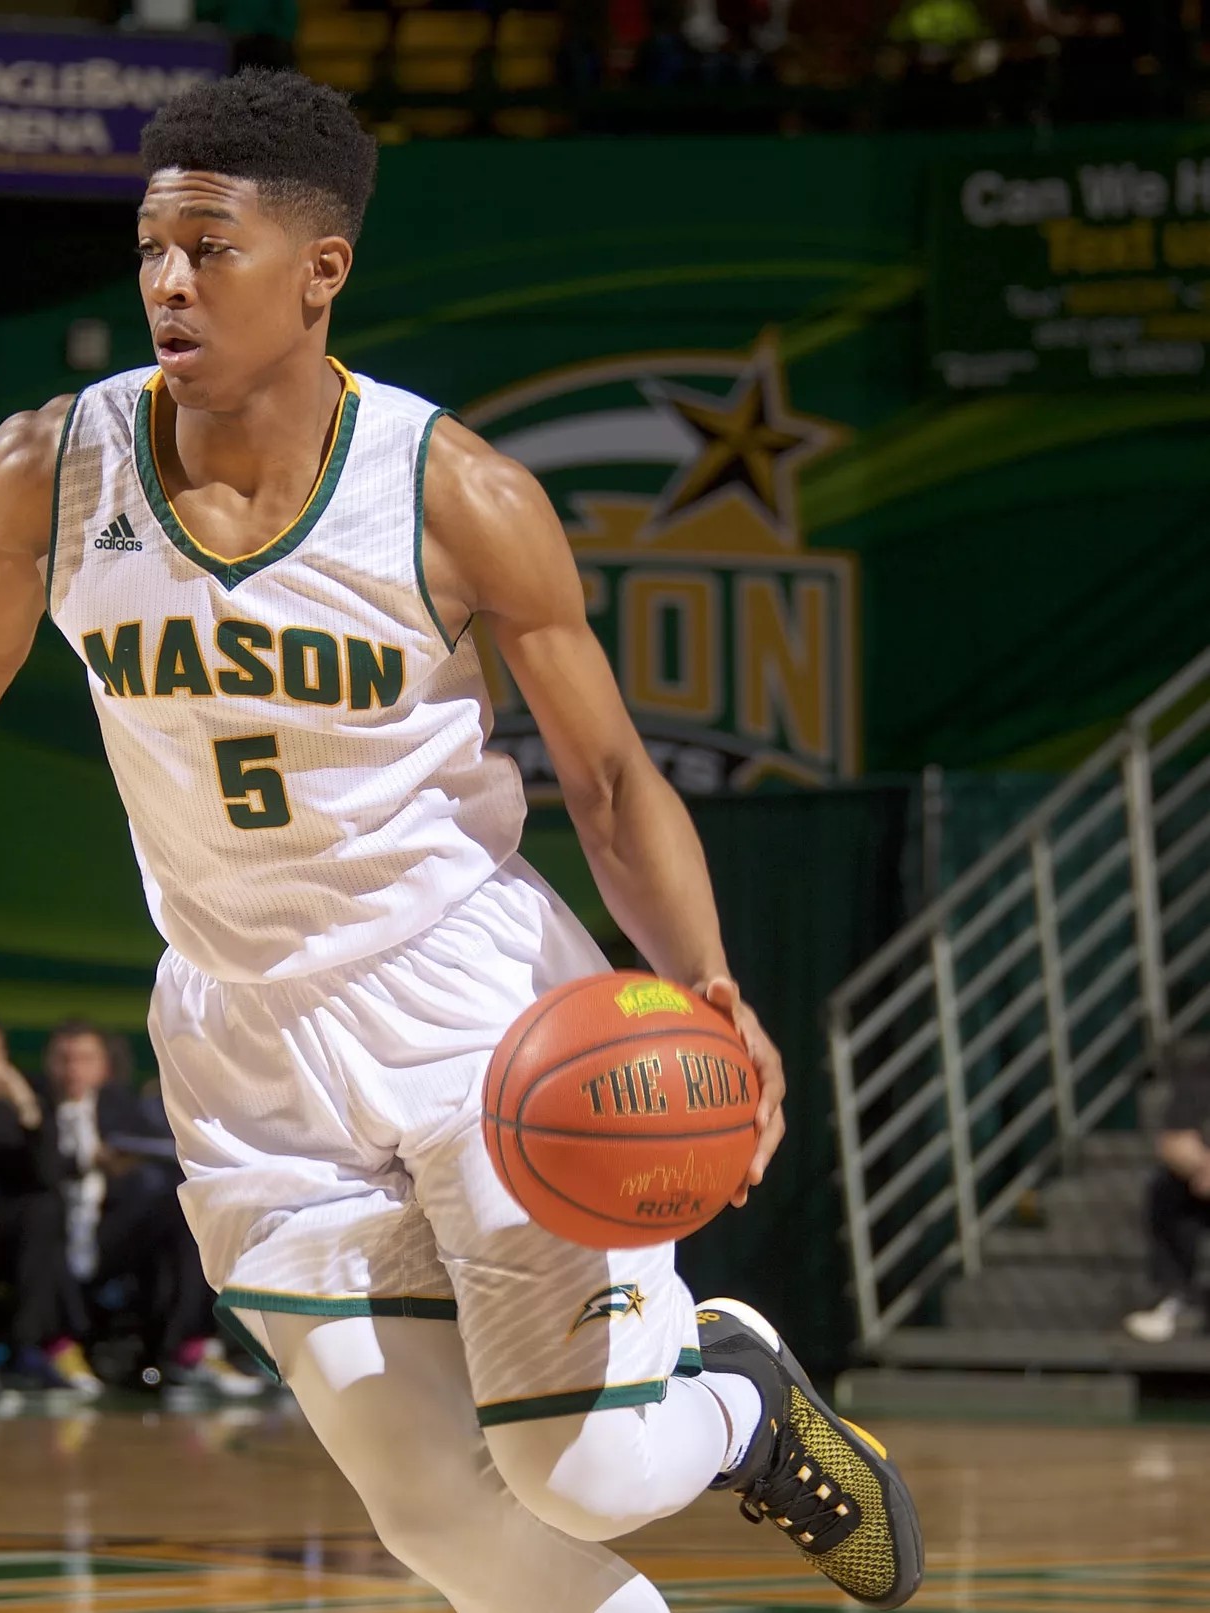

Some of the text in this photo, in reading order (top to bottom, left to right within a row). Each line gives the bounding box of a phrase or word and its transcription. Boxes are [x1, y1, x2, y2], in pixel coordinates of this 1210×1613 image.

[962, 170, 1070, 227] Can
[1080, 163, 1168, 218] We
[94, 536, 143, 551] adidas
[81, 616, 406, 712] MASON
[210, 732, 293, 830] 5
[580, 1048, 750, 1116] THE ROCK
